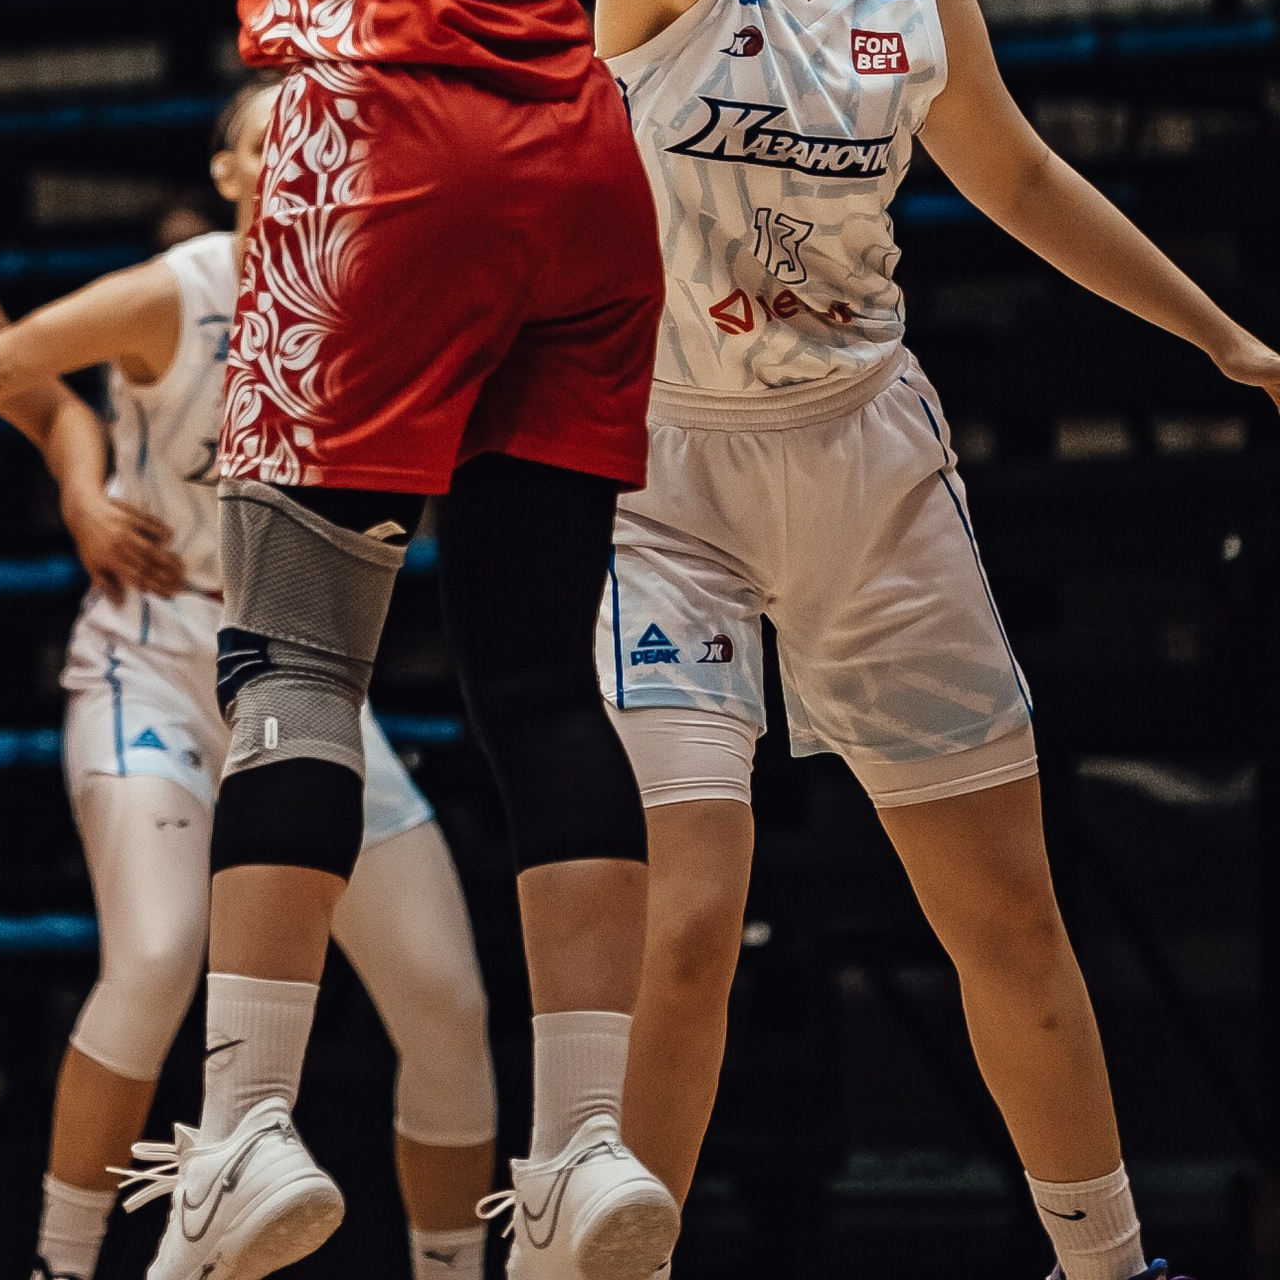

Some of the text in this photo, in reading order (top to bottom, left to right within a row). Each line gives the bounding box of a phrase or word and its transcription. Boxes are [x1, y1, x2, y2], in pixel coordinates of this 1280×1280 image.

[854, 36, 898, 53] FON
[857, 52, 902, 70] BET
[754, 207, 814, 285] 13
[630, 648, 681, 666] PEAK
